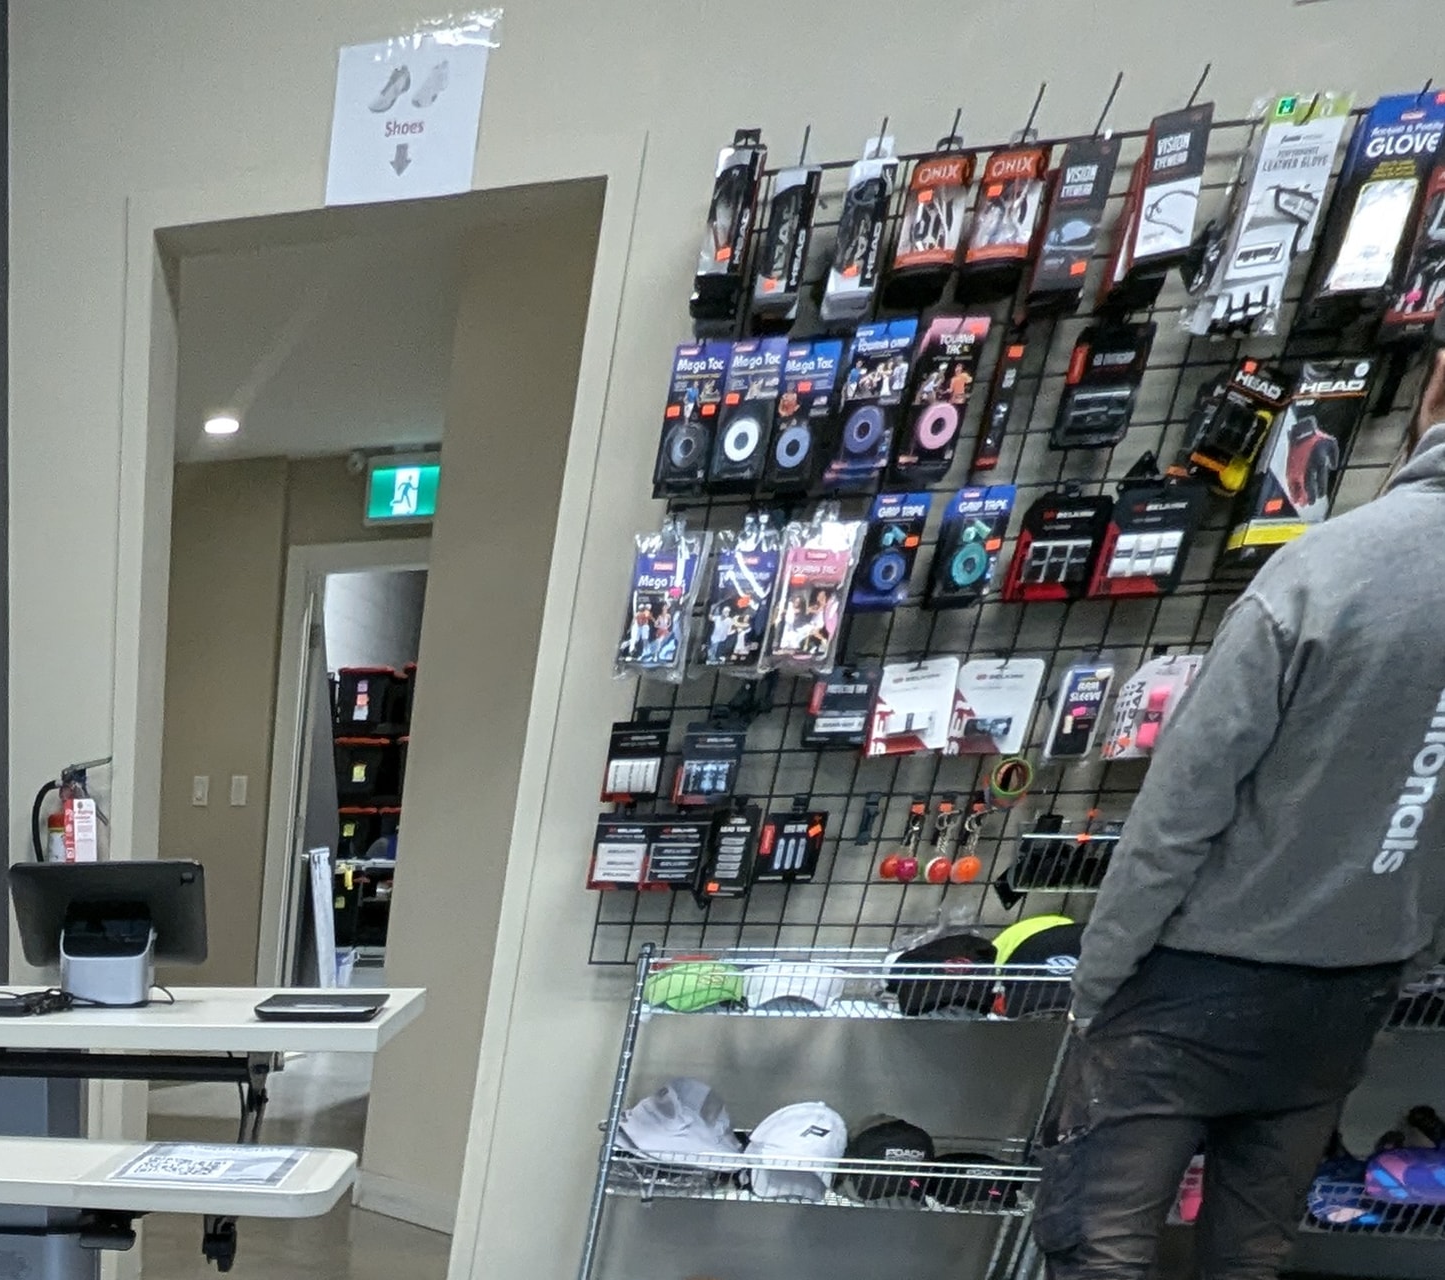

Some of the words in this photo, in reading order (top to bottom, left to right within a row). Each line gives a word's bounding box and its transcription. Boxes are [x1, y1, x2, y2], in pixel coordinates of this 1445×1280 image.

[385, 119, 425, 138] Shoes
[1366, 131, 1443, 159] GLOVE
[918, 163, 960, 184] ONIX
[991, 156, 1034, 176] ONIX
[1235, 371, 1284, 400] HEAD
[1300, 380, 1367, 394] HEAD
